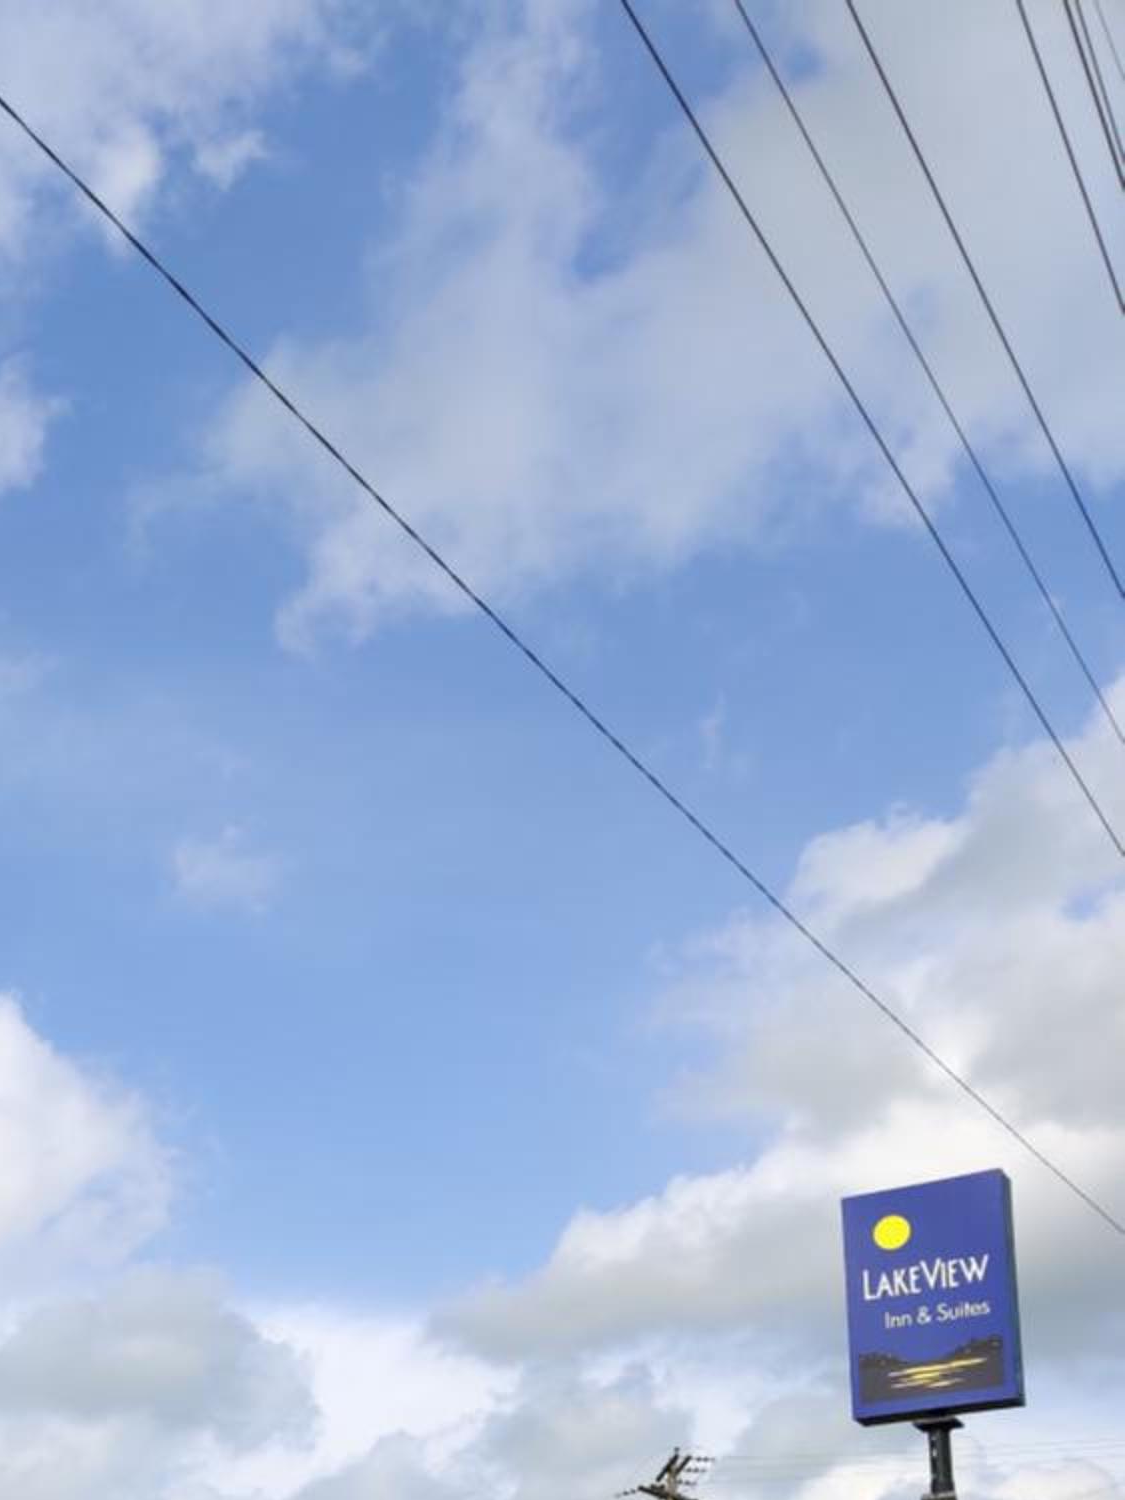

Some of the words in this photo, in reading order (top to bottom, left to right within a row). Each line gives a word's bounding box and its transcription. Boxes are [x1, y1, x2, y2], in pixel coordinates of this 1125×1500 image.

[884, 1311, 913, 1329] Inn
[916, 1306, 932, 1326] &
[936, 1301, 991, 1322] Suites
